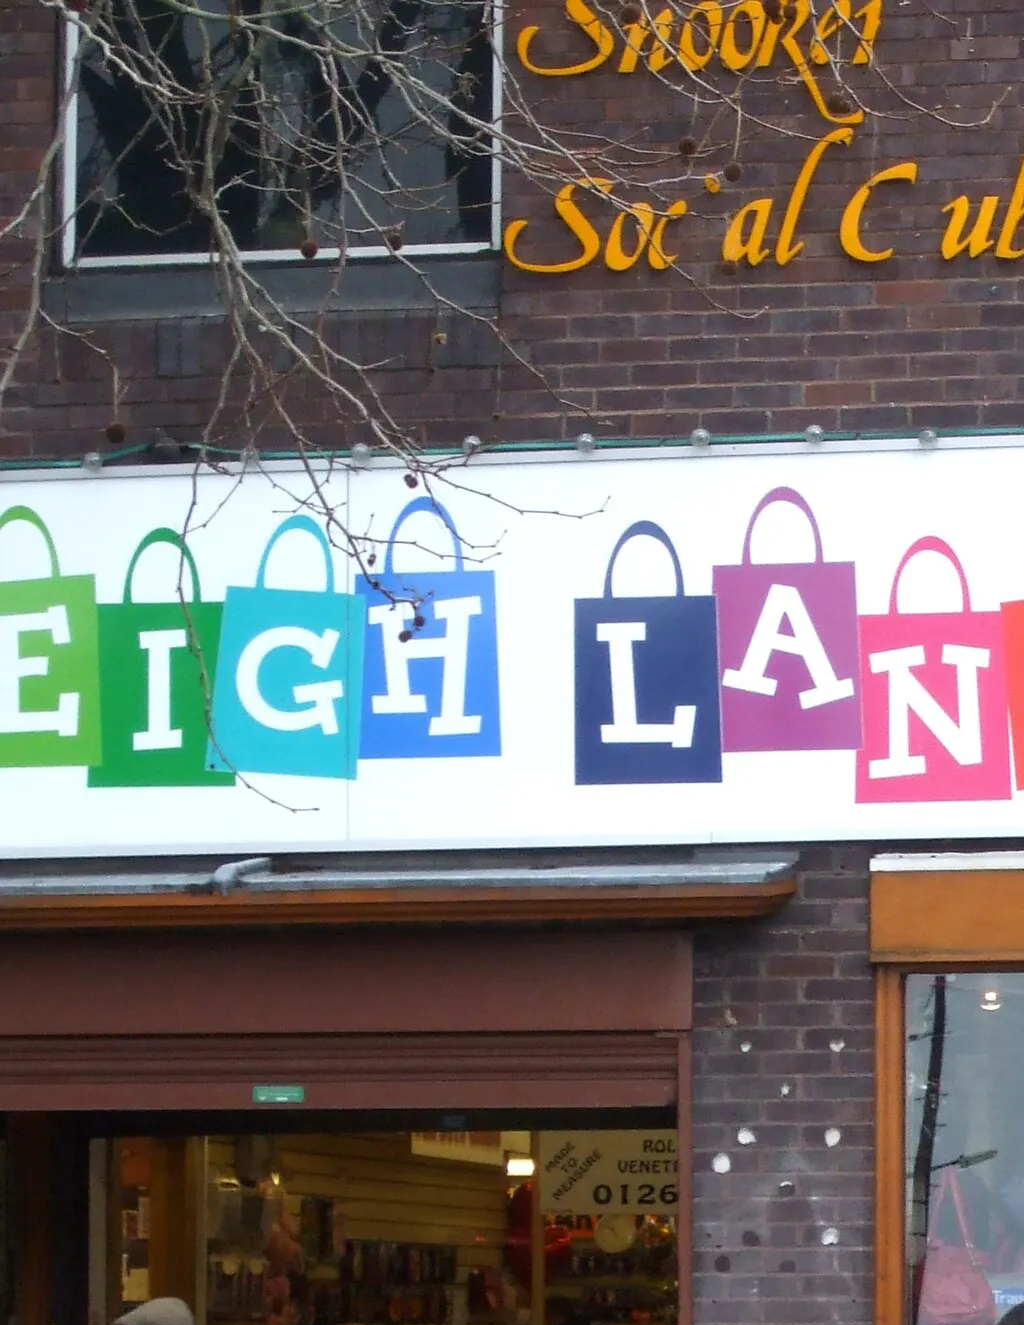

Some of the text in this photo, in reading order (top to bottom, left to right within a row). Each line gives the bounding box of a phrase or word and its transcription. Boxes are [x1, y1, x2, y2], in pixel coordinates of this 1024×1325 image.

[552, 1148, 602, 1200] MEASURE
[561, 1157, 579, 1173] TO
[592, 1183, 678, 1205] 0126
